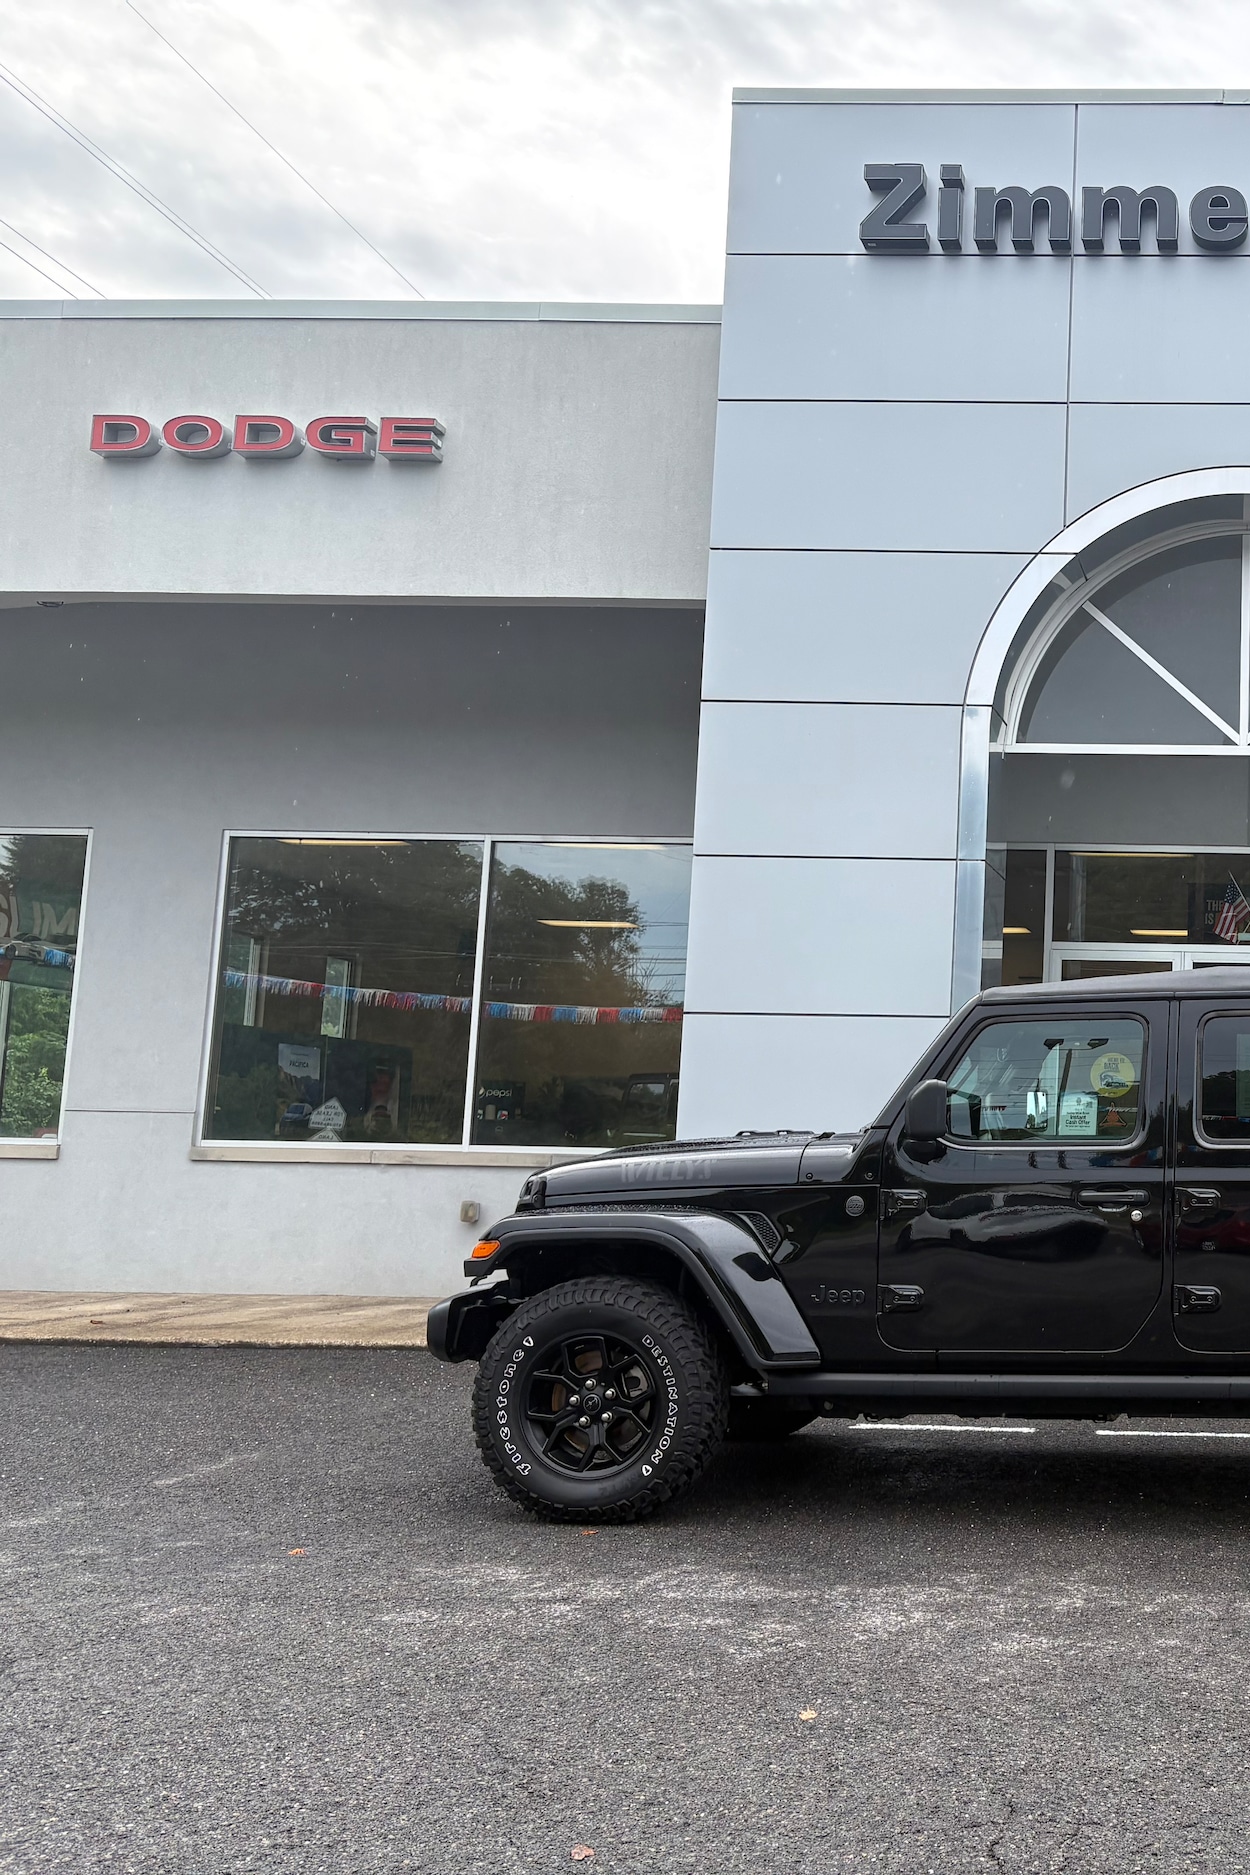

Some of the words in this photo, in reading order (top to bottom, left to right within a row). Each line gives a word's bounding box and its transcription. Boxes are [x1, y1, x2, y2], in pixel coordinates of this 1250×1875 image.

[90, 414, 445, 460] DODGE
[485, 1088, 513, 1098] pepsi
[621, 1159, 717, 1183] WILLYS
[811, 1284, 866, 1307] Jeep
[495, 1347, 533, 1477] Firestone
[641, 1334, 679, 1466] DESTINATION
